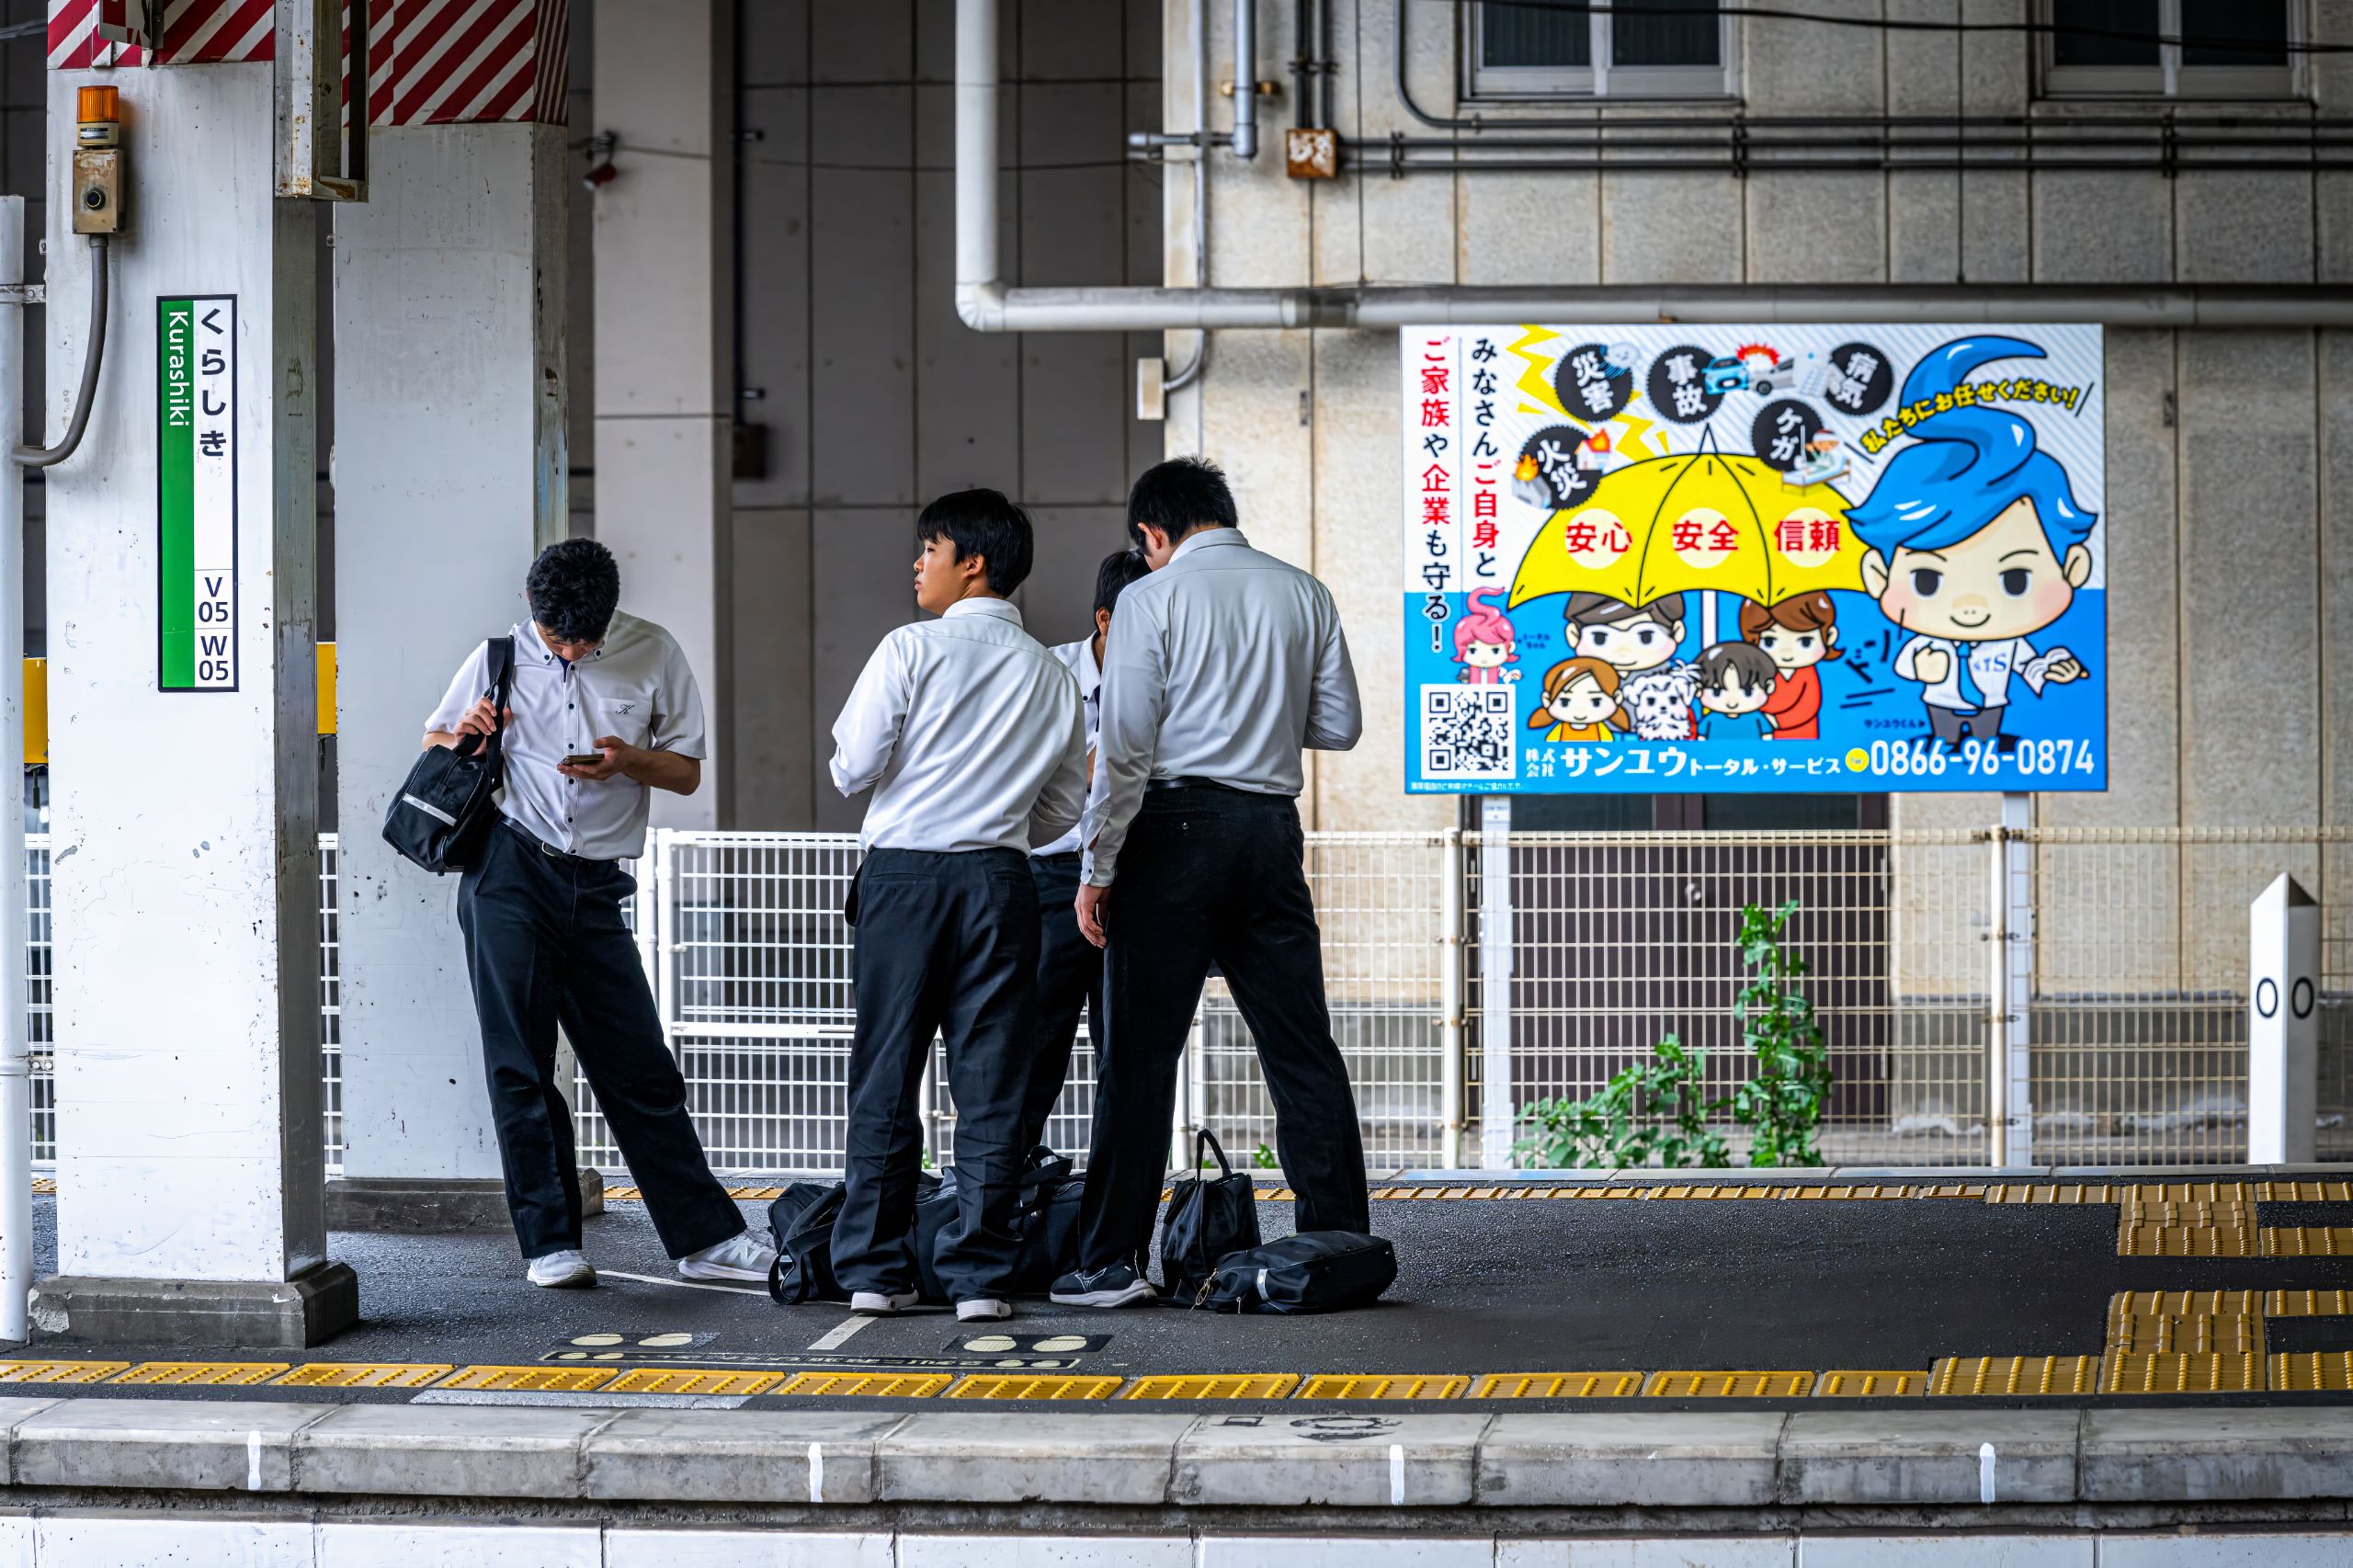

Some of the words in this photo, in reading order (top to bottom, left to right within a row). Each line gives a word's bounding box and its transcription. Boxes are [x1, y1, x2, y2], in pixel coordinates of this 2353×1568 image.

[168, 311, 190, 426] Kurashiki
[200, 308, 227, 457] くらしき
[1572, 350, 1615, 414] 災害
[1665, 354, 1708, 417] 事故
[1835, 351, 1879, 410] 病気
[1769, 406, 1803, 461] ケガ
[1859, 378, 2081, 454] 私たちにお任せください!
[1472, 337, 1502, 577] みなさんご自身と
[1537, 438, 1587, 501] 火災
[1420, 335, 1451, 651] ご家族や企業も守る!
[1565, 521, 1633, 553] 安心
[1672, 519, 1739, 551] 安全
[1773, 519, 1842, 552] 信頼
[198, 601, 229, 622] 05
[204, 576, 223, 597] V
[199, 635, 229, 656] W
[199, 660, 229, 681] 05
[1870, 738, 2096, 776] 0866-96-0874
